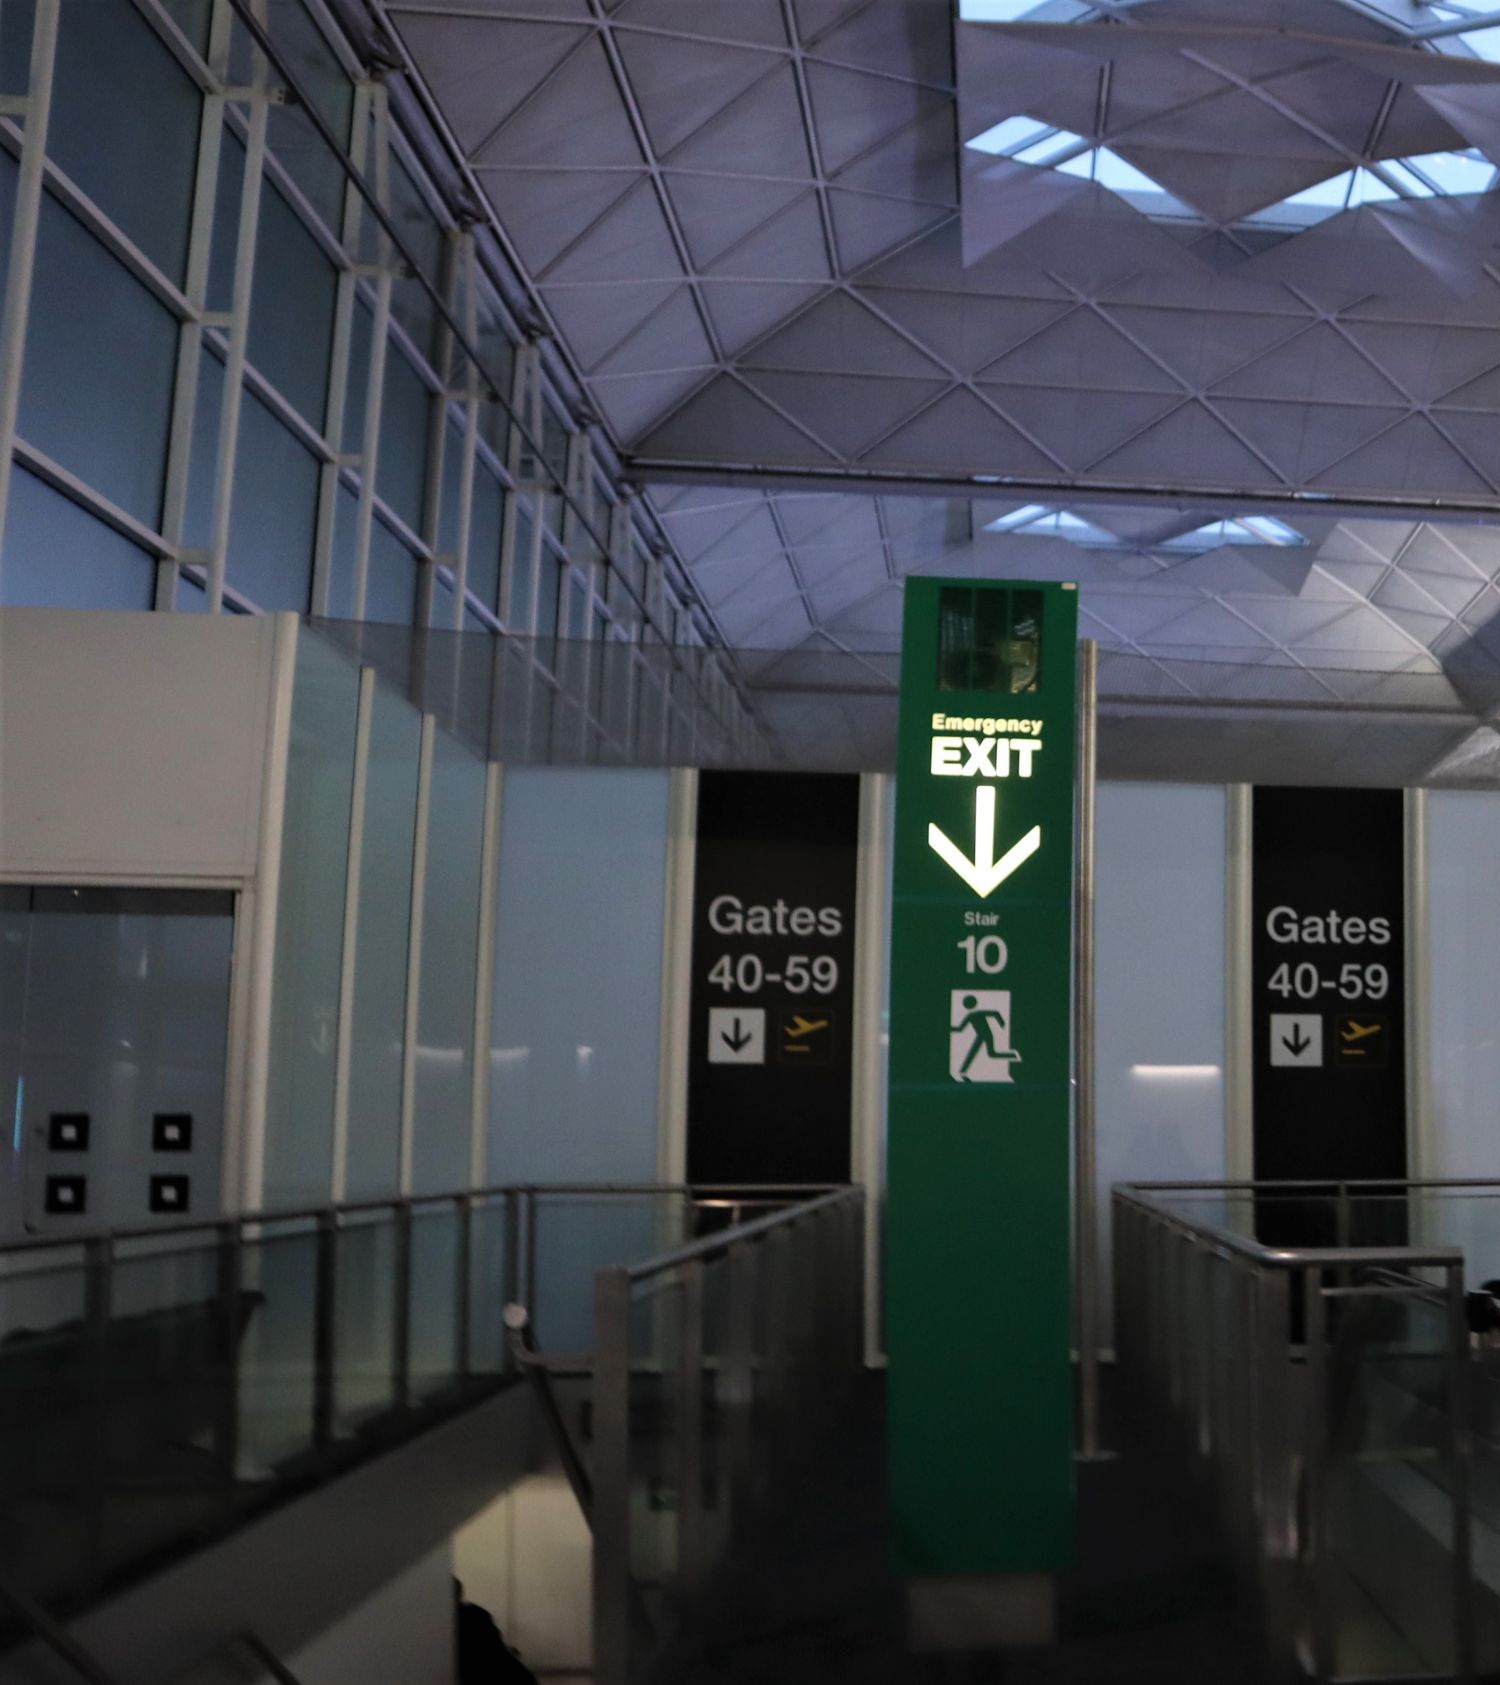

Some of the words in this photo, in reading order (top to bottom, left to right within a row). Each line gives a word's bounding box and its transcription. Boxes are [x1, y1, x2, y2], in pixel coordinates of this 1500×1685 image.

[931, 712, 1043, 736] Emergency
[931, 735, 1043, 778] EXIT
[708, 894, 843, 937] Gates
[964, 911, 1000, 927] Stair
[1265, 905, 1392, 945] Gates
[707, 953, 839, 994] 40-59
[957, 935, 1009, 974] 10
[1267, 962, 1390, 1000] 40-59
